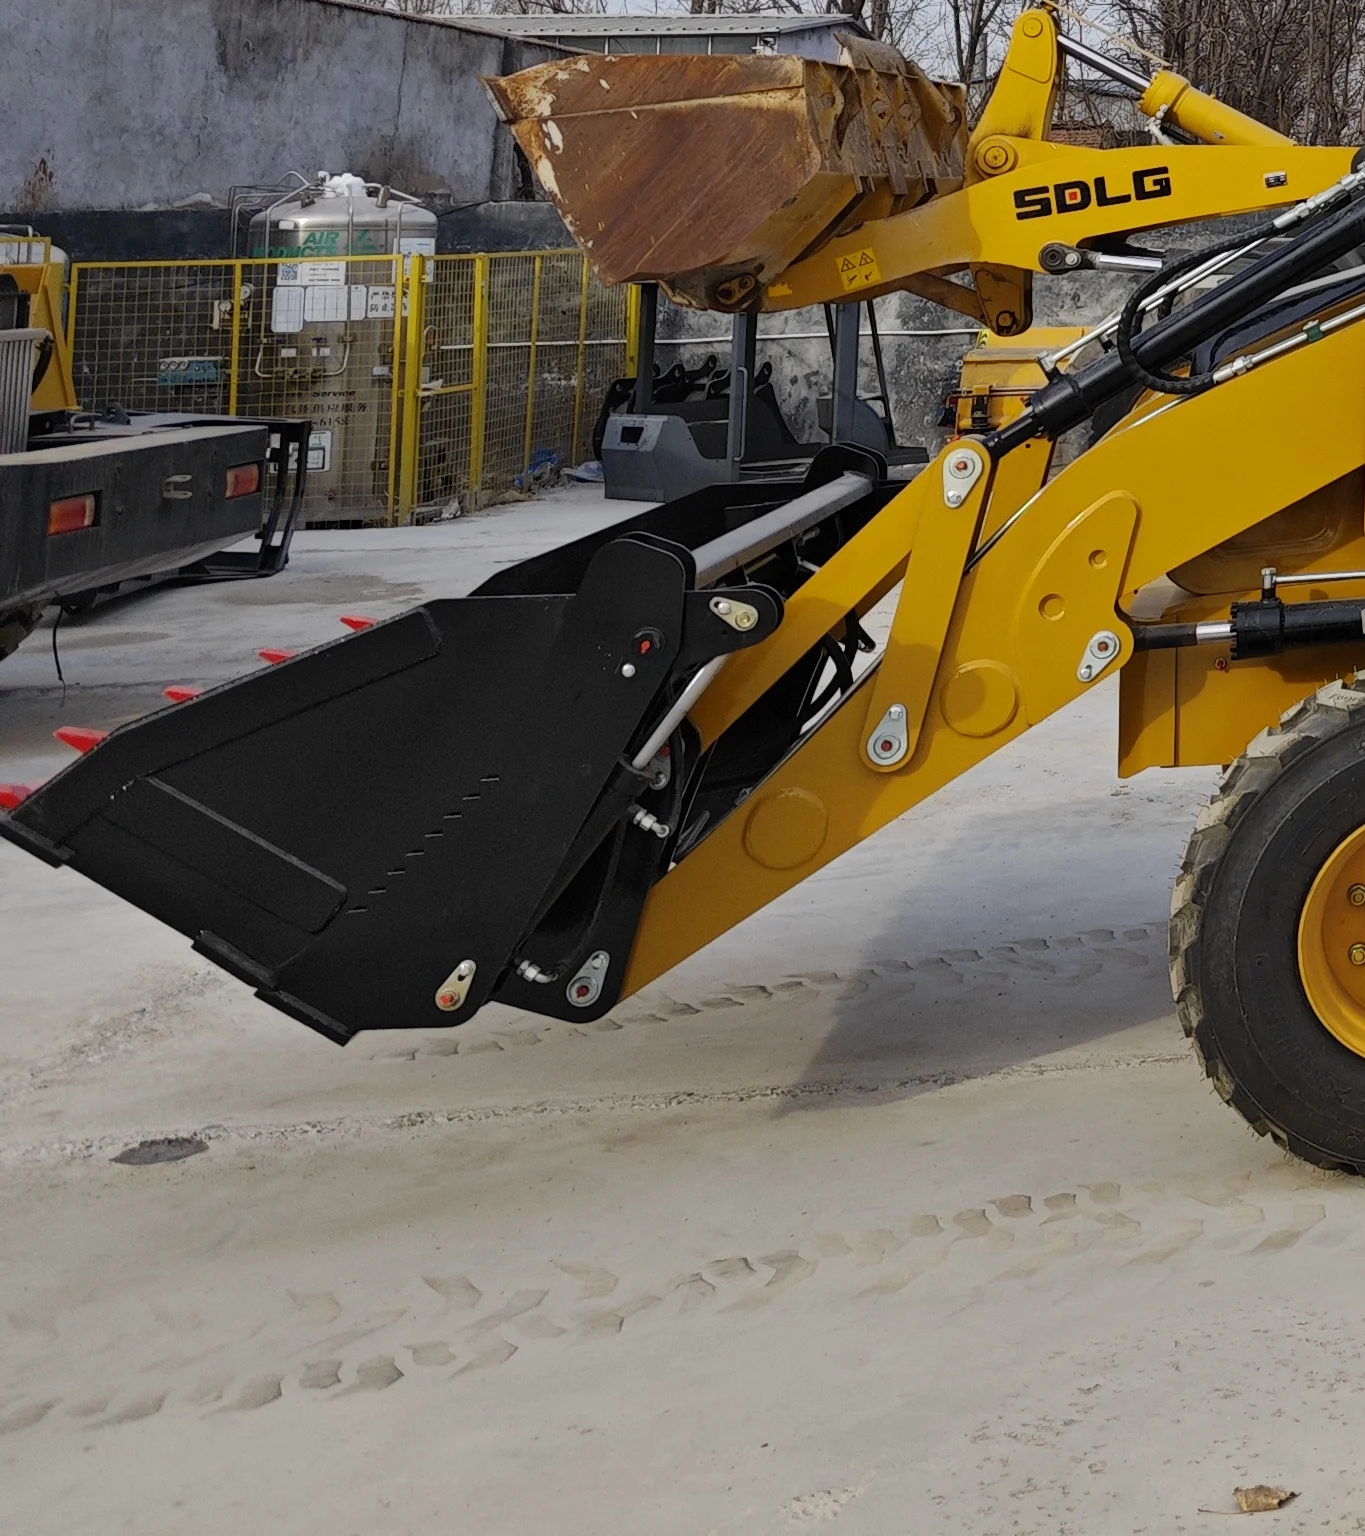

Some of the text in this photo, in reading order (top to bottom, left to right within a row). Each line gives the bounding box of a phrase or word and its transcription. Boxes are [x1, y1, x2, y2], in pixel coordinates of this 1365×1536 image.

[1013, 166, 1171, 220] SDLG
[303, 231, 339, 245] AIR
[312, 390, 356, 398] Service
